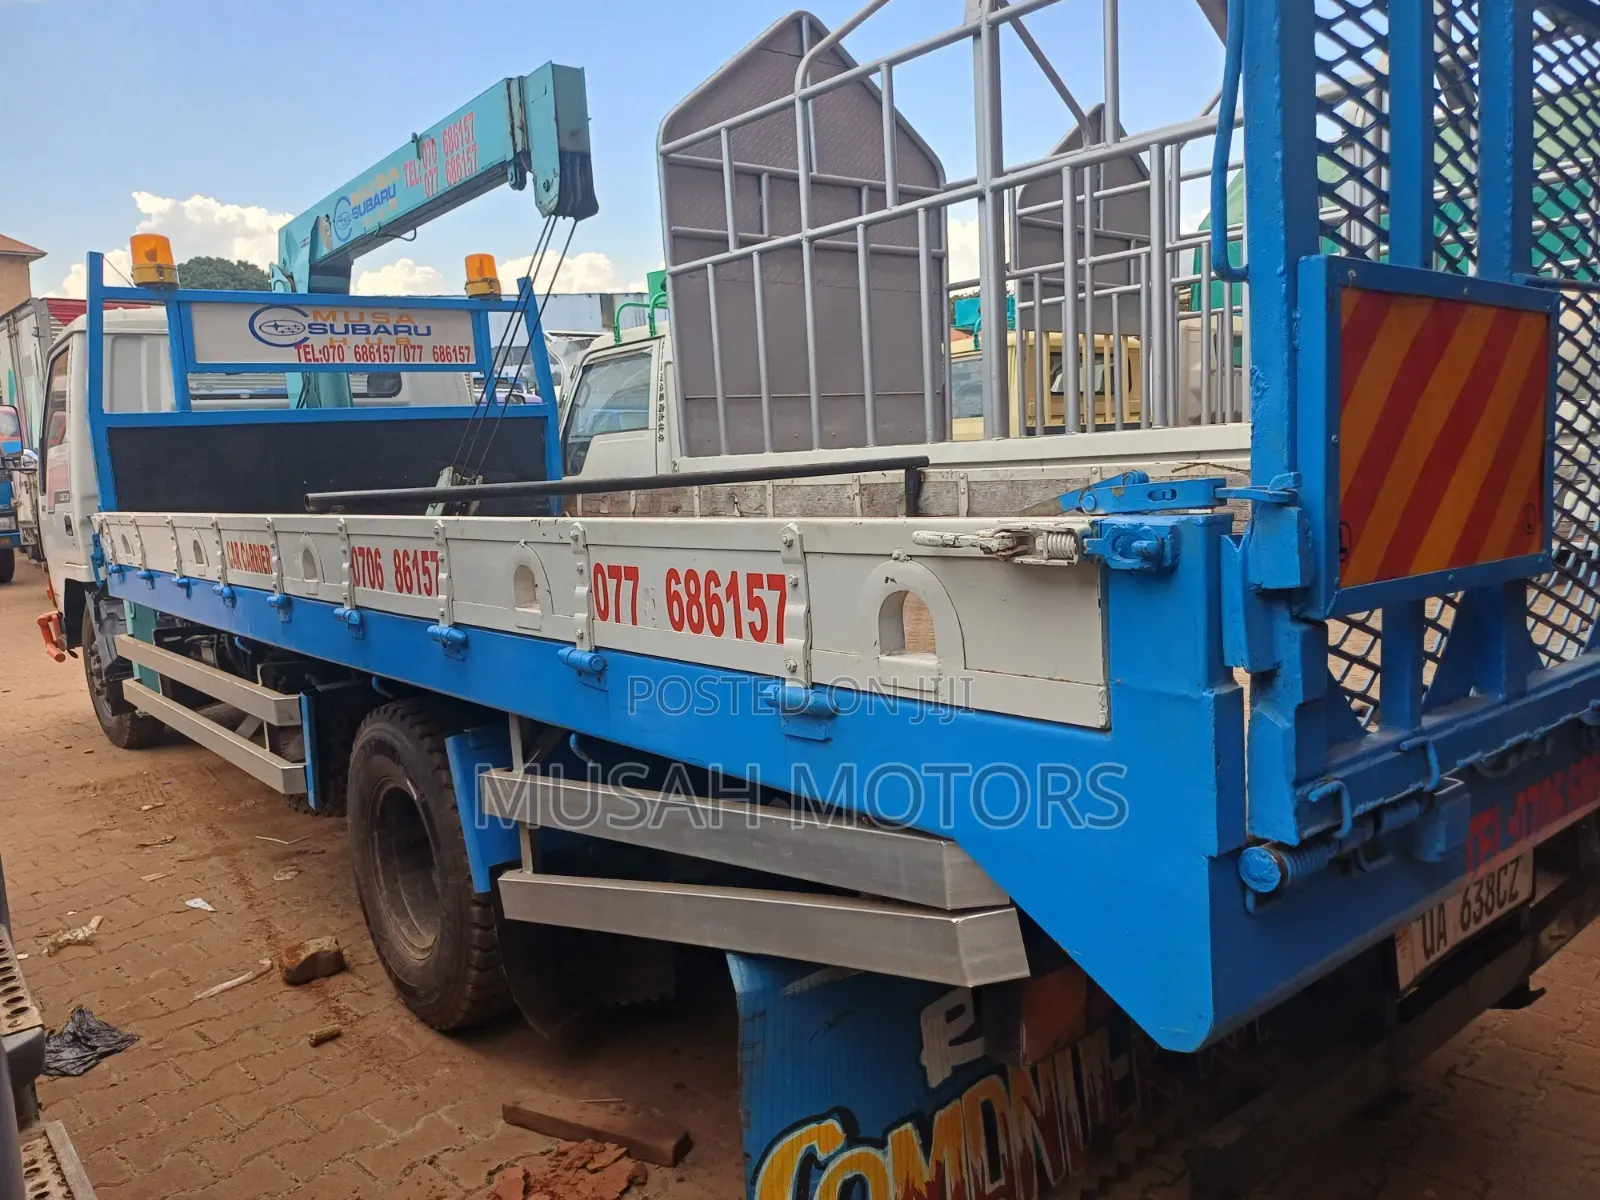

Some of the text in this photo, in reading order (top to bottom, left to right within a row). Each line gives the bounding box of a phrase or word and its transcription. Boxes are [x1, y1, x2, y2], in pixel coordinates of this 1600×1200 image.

[442, 111, 475, 158] 686157
[424, 142, 478, 198] 077 686157
[351, 182, 397, 220] SUBARU
[307, 322, 432, 337] SUBARU
[312, 309, 415, 323] MUSA
[328, 336, 412, 347] HUB
[432, 345, 472, 363] 686157
[226, 540, 273, 575] CAR CARRIER
[350, 546, 440, 597] 0706 86157
[593, 562, 787, 645] 077 686157
[1420, 902, 1448, 960] UA
[1459, 856, 1522, 932] 638CZ
